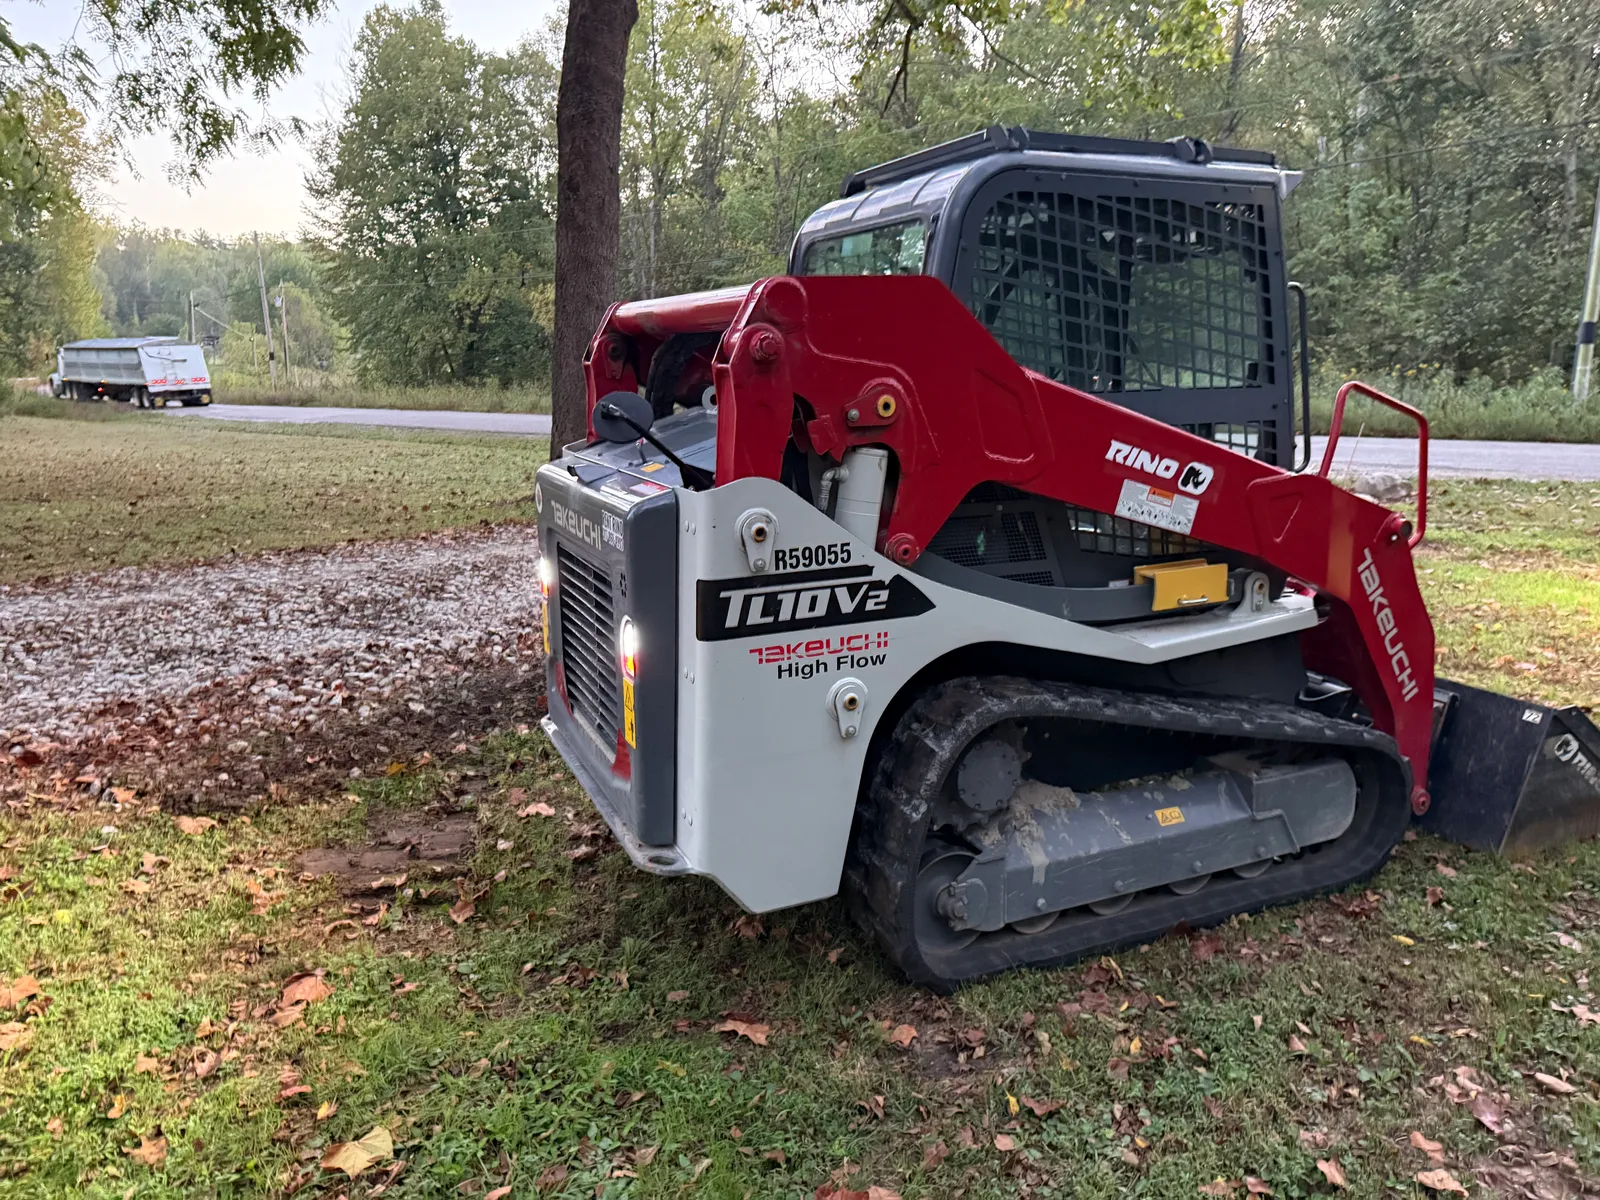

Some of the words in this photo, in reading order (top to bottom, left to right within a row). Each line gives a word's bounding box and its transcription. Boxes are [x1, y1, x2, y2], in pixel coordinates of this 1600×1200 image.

[1105, 439, 1180, 480] RINO
[551, 501, 601, 551] TAKEUCHI
[774, 542, 852, 571] R59055
[719, 582, 890, 629] TL10V2
[1357, 547, 1419, 702] TAKEUCHI
[749, 631, 889, 665] TAKEUCHI
[777, 659, 828, 680] High
[836, 653, 887, 671] Flow
[1571, 751, 1600, 795] RIN
